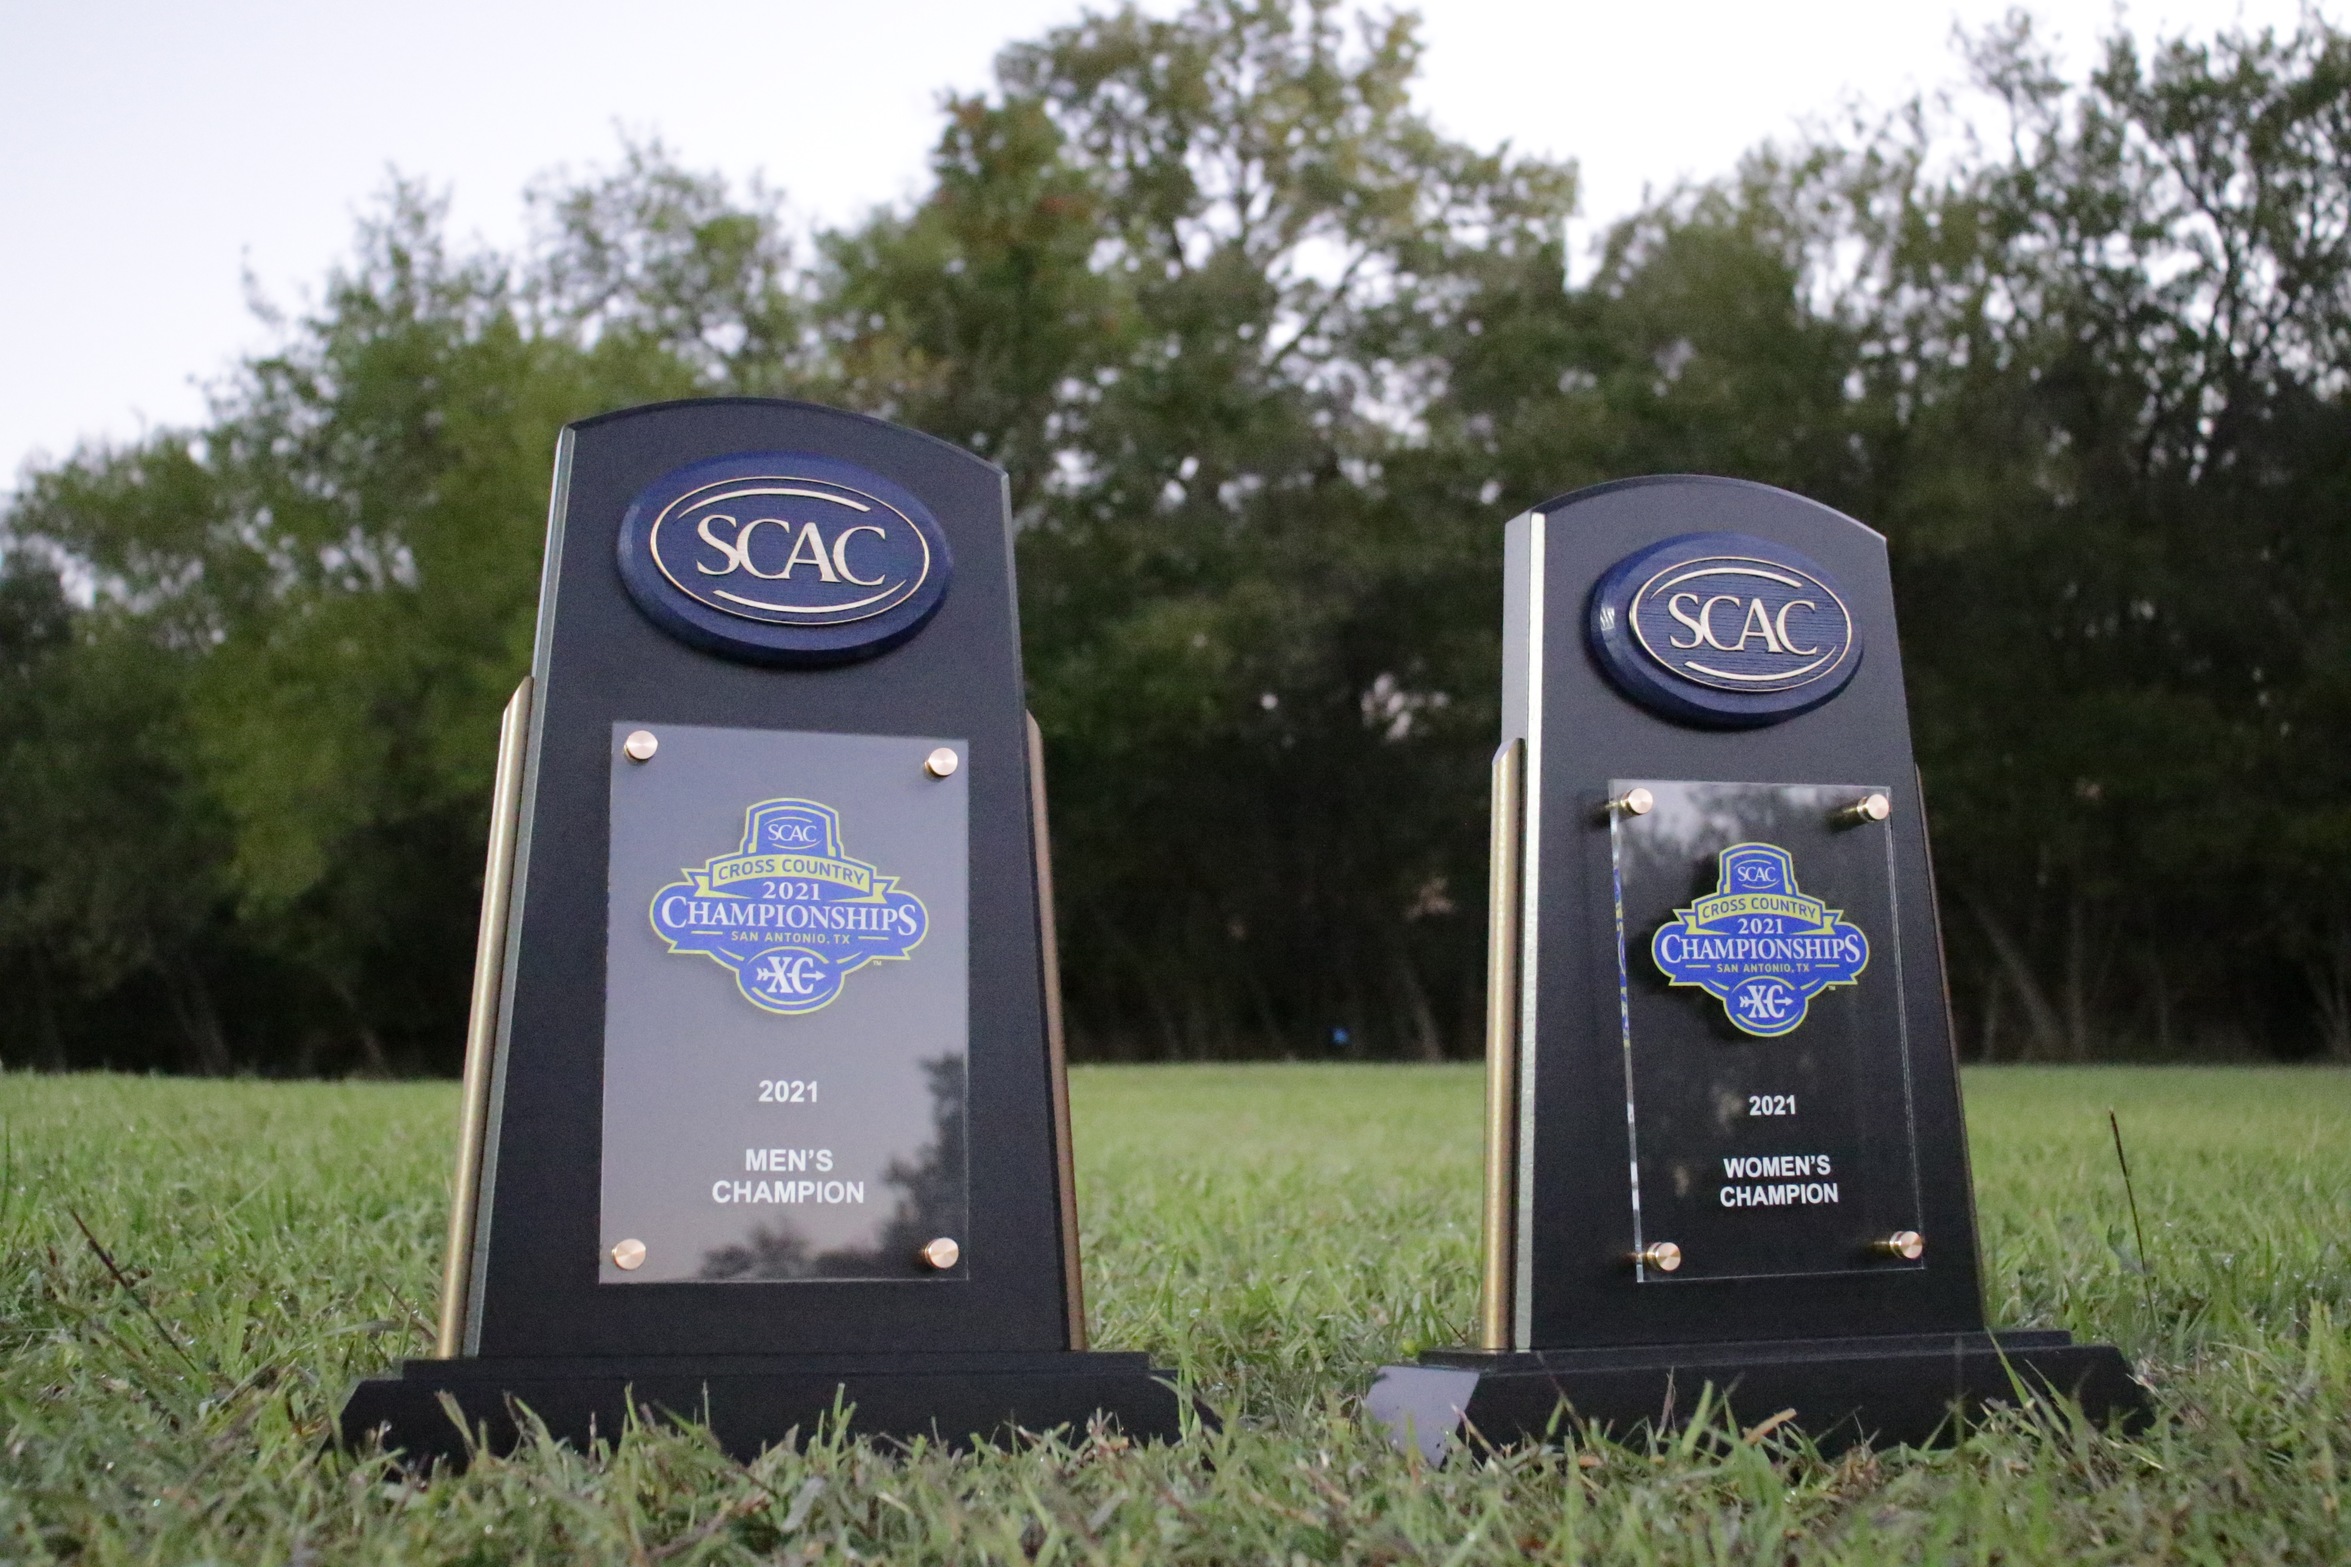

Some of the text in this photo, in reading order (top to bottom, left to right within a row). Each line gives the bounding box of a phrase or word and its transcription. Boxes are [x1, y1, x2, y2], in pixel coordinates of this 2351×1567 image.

[696, 514, 886, 586] SCAC
[1668, 593, 1818, 655] SCAC
[768, 824, 817, 843] SCAC
[718, 858, 864, 885] CROSS COUNTRY
[1737, 866, 1776, 882] SCAC
[762, 881, 821, 900] 2021
[661, 896, 917, 935] CHAMPIONSHIPS
[1702, 897, 1816, 919] CROSS COUNTRY
[731, 930, 759, 942] SAN
[833, 933, 850, 945] TX
[1737, 918, 1784, 935] 2021
[1661, 934, 1860, 963] CHAMPIONSHIPS
[767, 956, 814, 993] XC
[1716, 963, 1739, 973] SAN
[1796, 963, 1810, 973] TX
[1747, 985, 1785, 1018] XC
[758, 1080, 818, 1103] 2021
[1749, 1095, 1796, 1116] 2021
[745, 1149, 834, 1172] MEN’S
[1723, 1155, 1831, 1179] WOMEN’S
[712, 1180, 864, 1203] CHAMPION
[1719, 1182, 1839, 1208] CHAMPION
